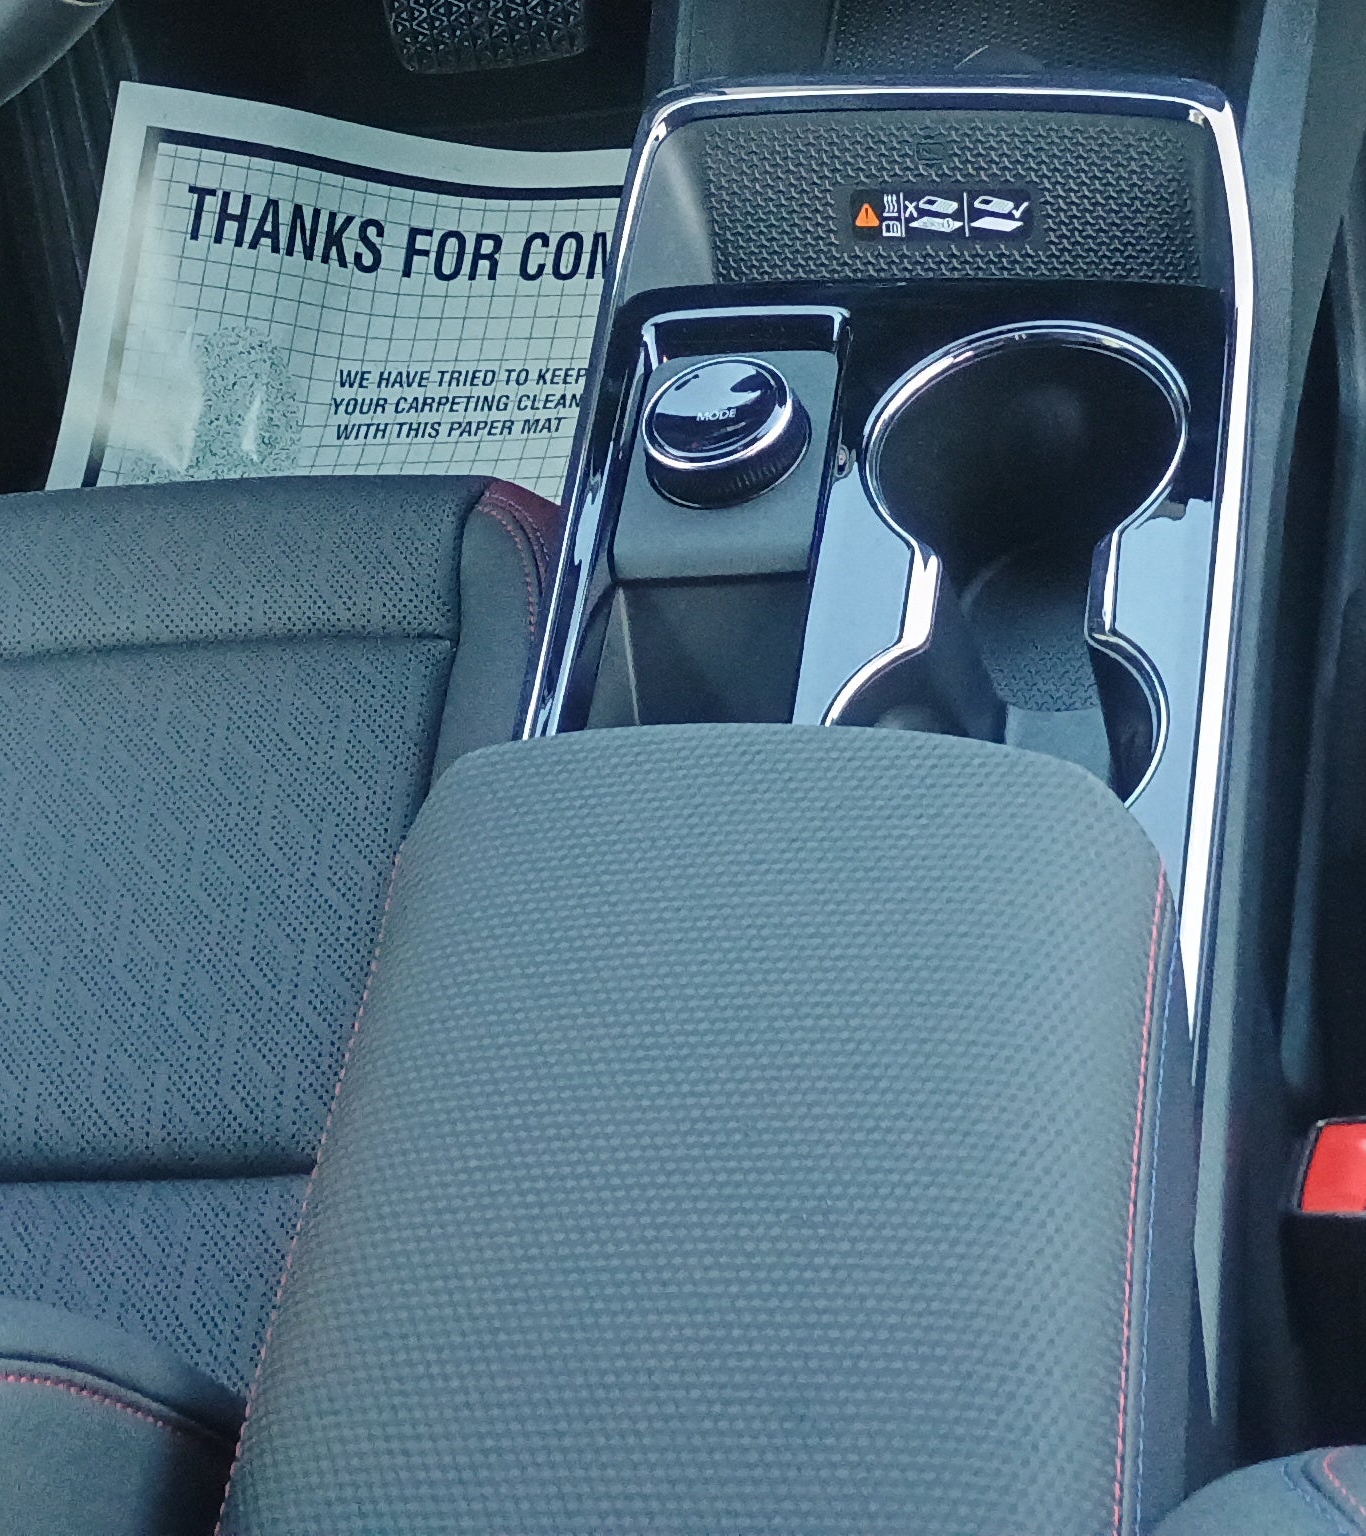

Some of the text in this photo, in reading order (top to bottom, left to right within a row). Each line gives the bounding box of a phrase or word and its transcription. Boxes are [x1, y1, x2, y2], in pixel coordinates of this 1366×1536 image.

[188, 184, 385, 273] THANKS
[401, 226, 503, 282] FOR
[339, 367, 588, 389] WE HAVE TRIED TO KEEP
[333, 393, 583, 416] YOUR CARPETING CLEAN
[696, 409, 737, 421] MODE
[336, 416, 568, 441] WITH THIS PAPER MAT
